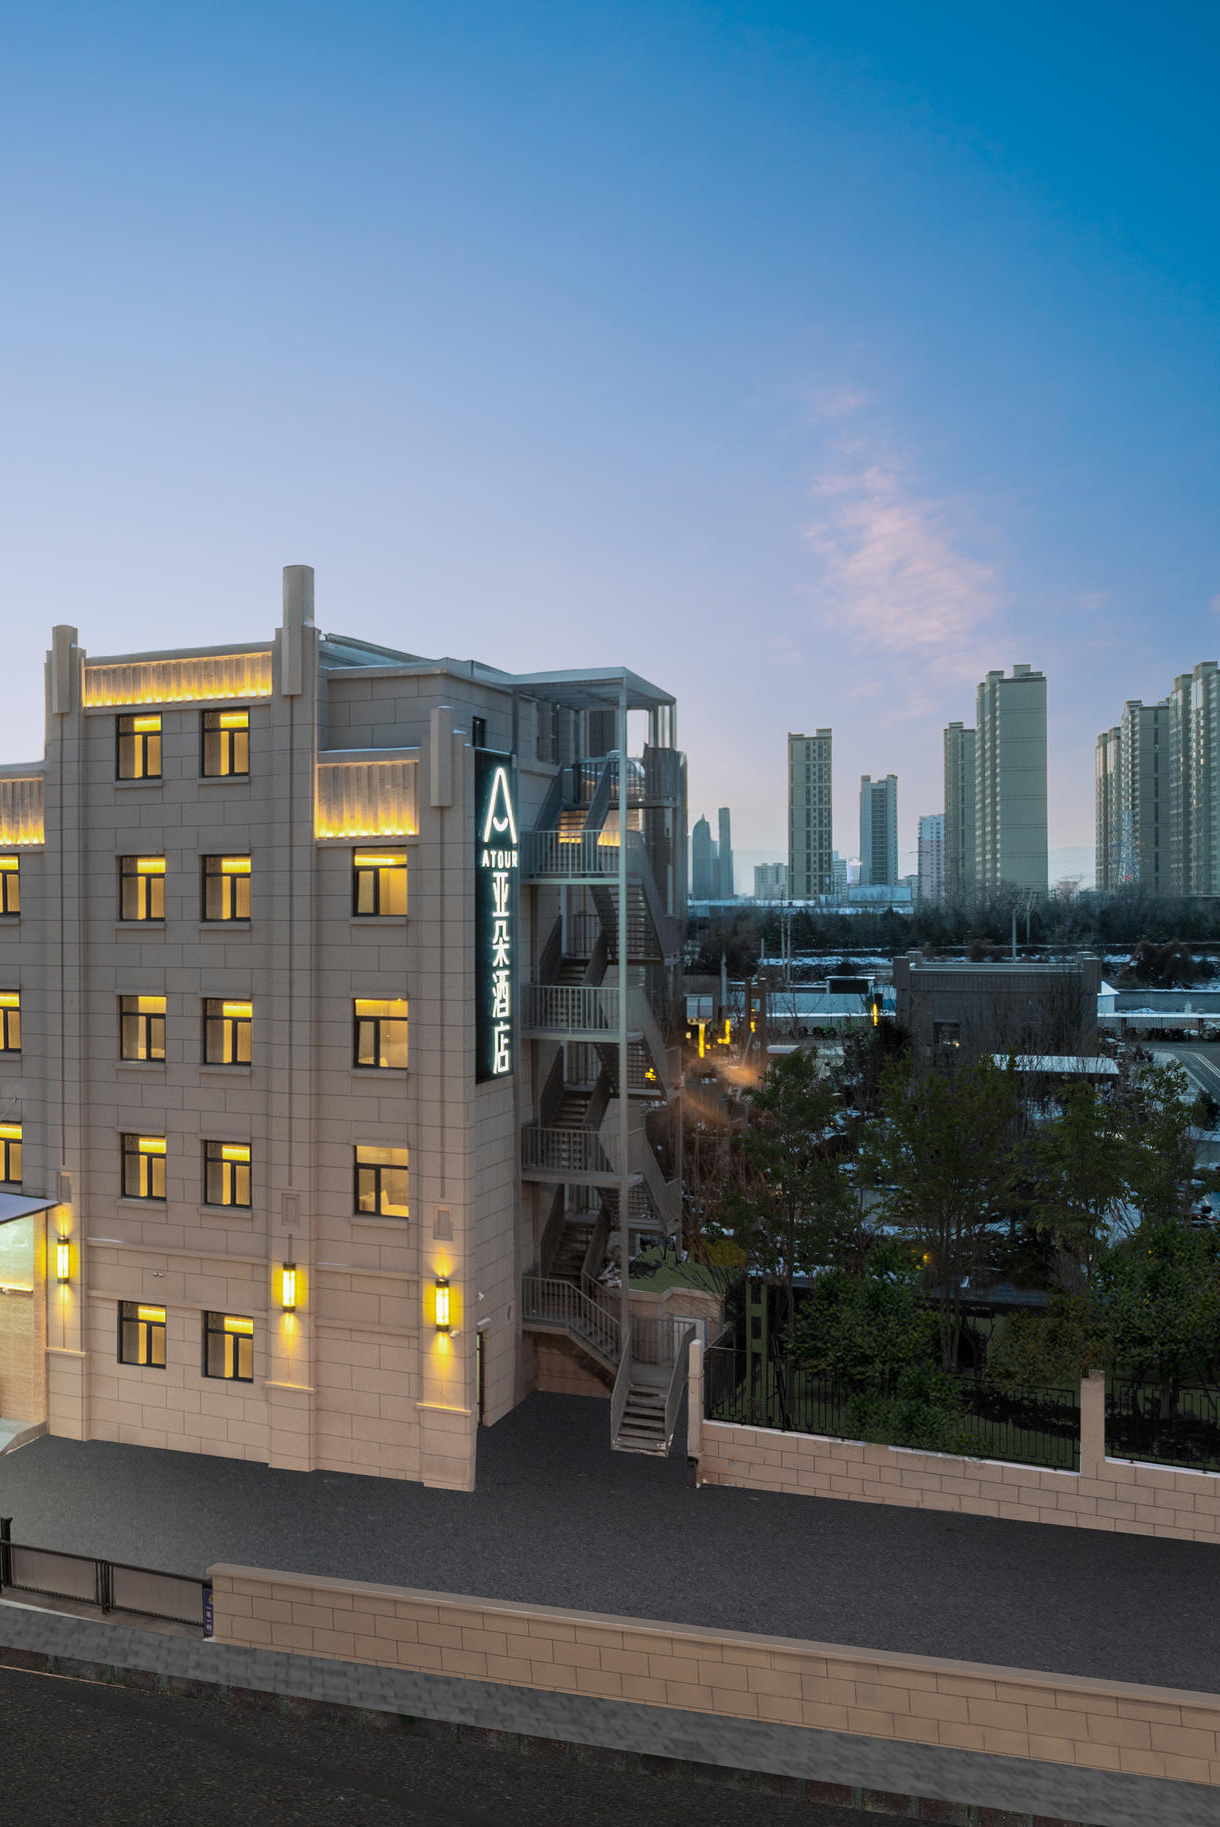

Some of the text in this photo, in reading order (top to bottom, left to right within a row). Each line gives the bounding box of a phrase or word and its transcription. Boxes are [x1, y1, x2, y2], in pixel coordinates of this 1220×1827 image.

[482, 849, 518, 869] ATOUR
[492, 872, 510, 1075] 亚朵酒店
